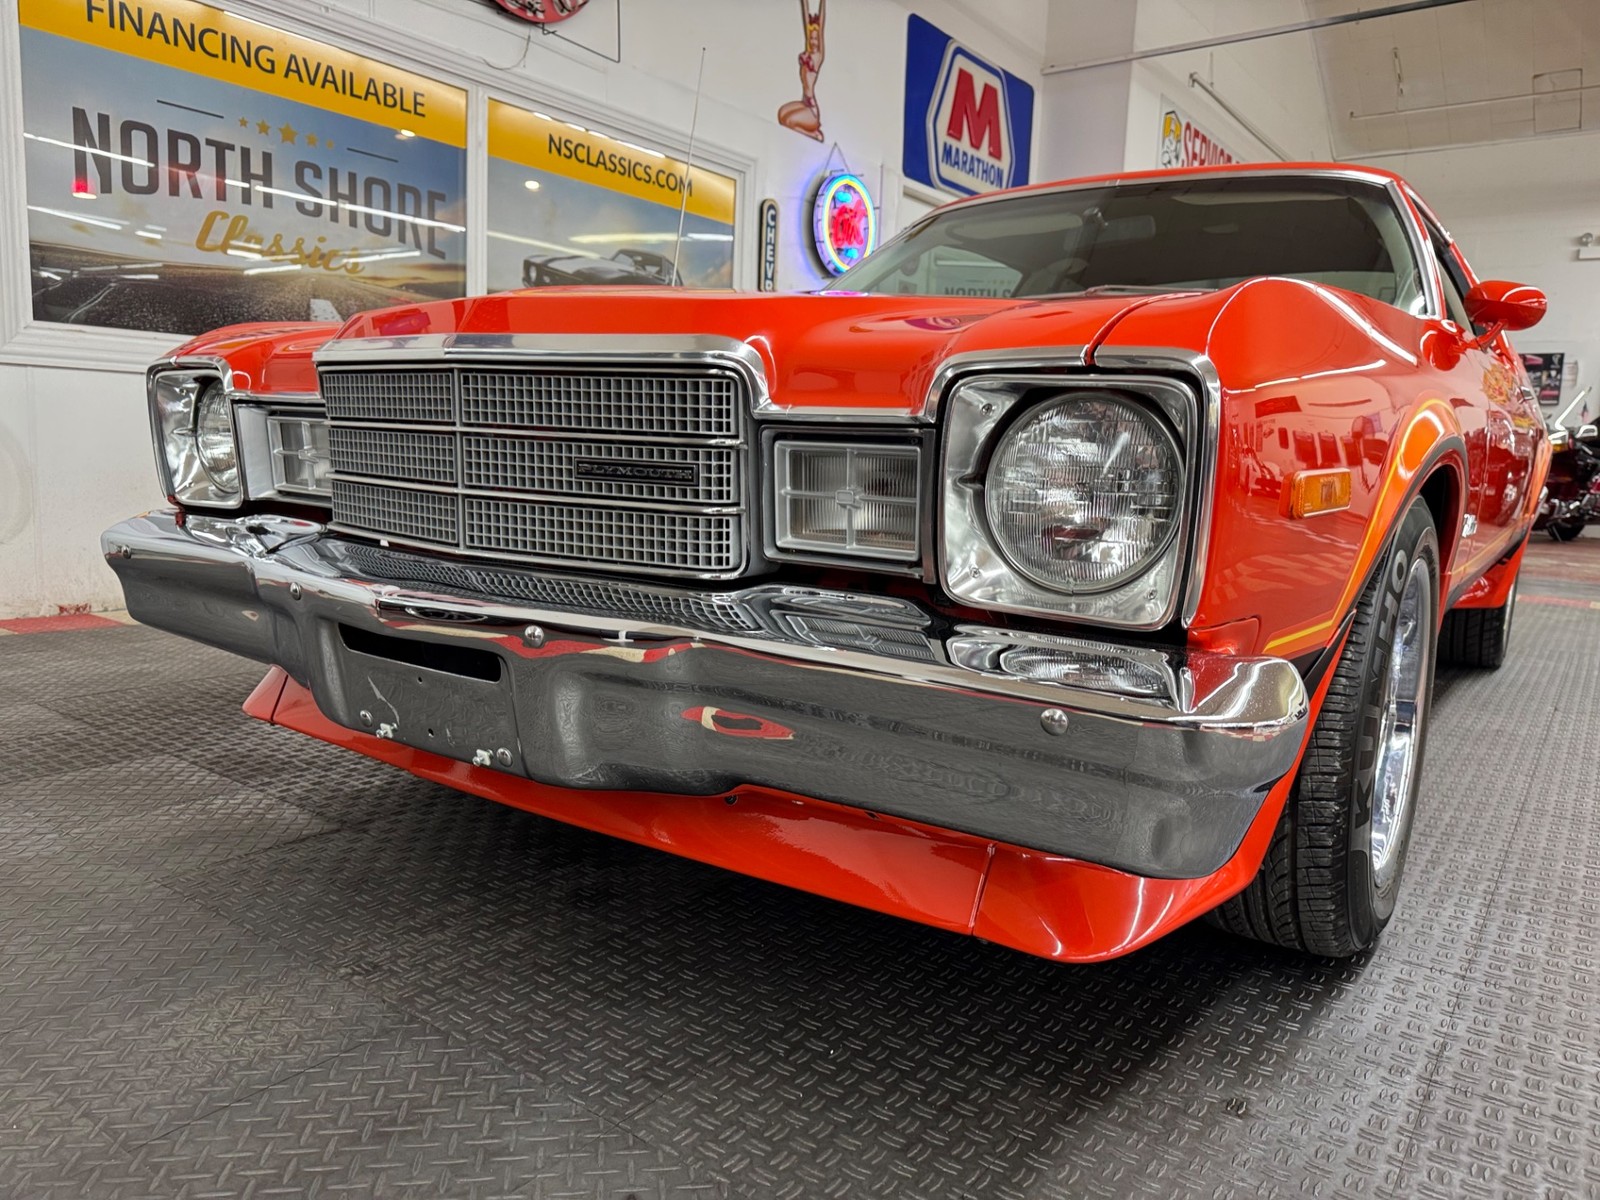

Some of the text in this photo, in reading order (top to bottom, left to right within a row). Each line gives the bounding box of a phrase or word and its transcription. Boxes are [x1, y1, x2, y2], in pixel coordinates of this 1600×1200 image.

[86, 0, 427, 118] FINANCING AVAILABLE
[946, 67, 1003, 162] M
[1181, 120, 1232, 168] SERV
[72, 106, 447, 260] NORTH SHORE
[548, 133, 693, 198] NSCLASSICS.COM
[941, 141, 1004, 189] MARATHON
[195, 210, 366, 275] Classics
[577, 463, 693, 480] PLYMOUTH
